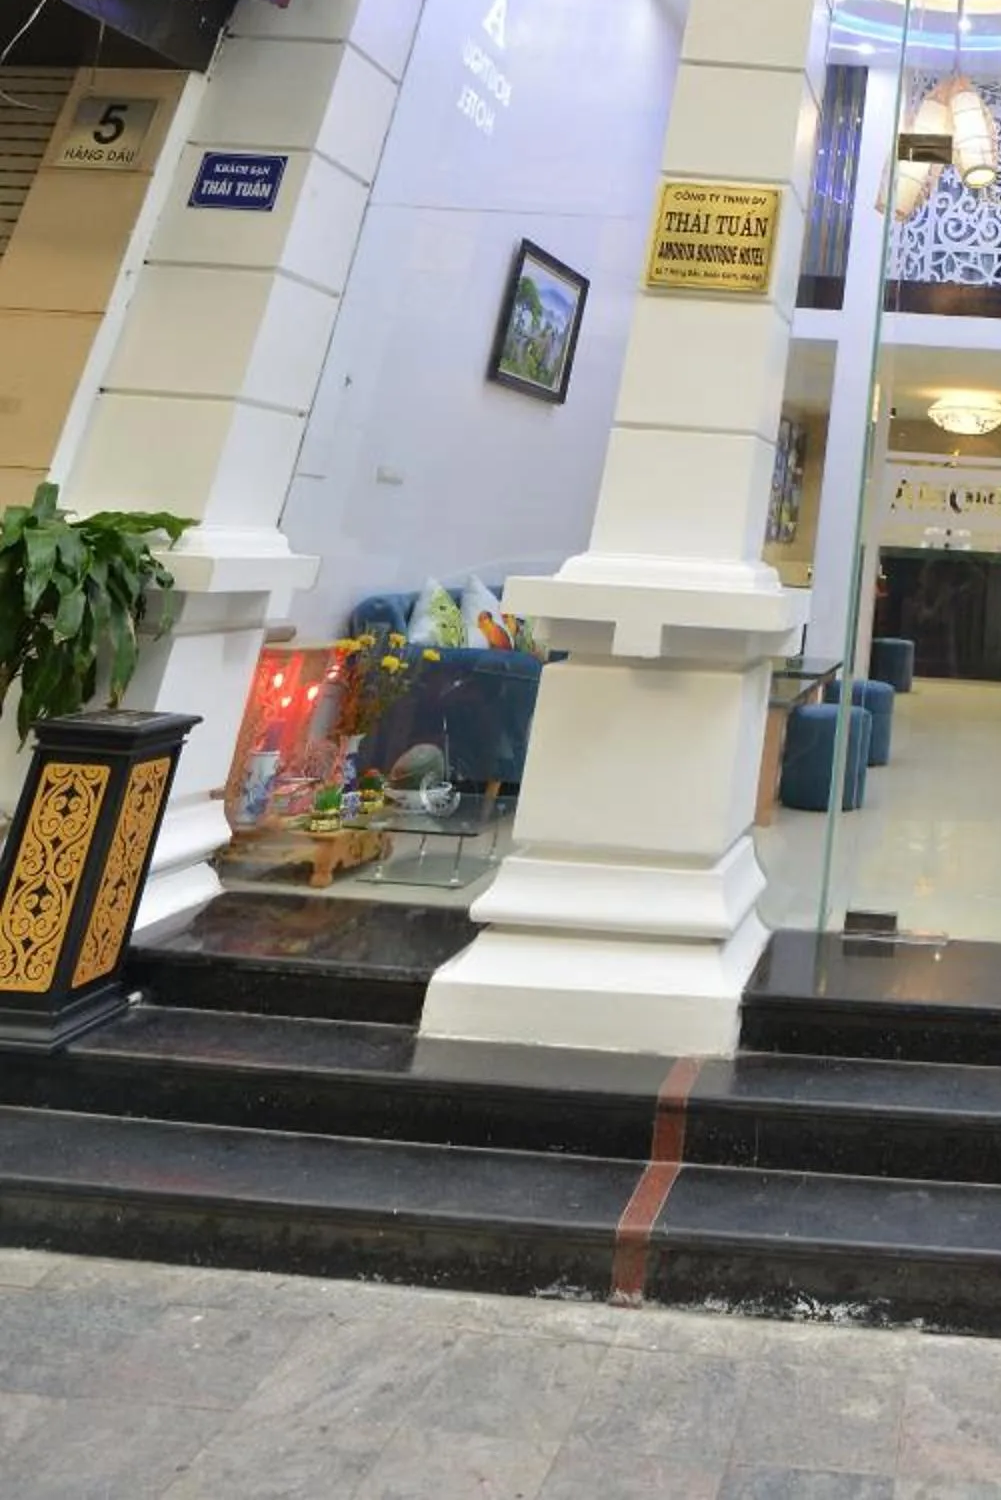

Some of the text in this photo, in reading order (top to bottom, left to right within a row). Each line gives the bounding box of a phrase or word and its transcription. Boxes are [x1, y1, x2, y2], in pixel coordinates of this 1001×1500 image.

[93, 104, 129, 145] 5
[201, 177, 272, 198] THÁI TUẤN
[673, 190, 706, 202] CÔNG
[709, 193, 721, 203] TY
[665, 209, 769, 238] THÁI TUẤN
[658, 241, 764, 266] AMORITA BOUTIQUE HOTEL
